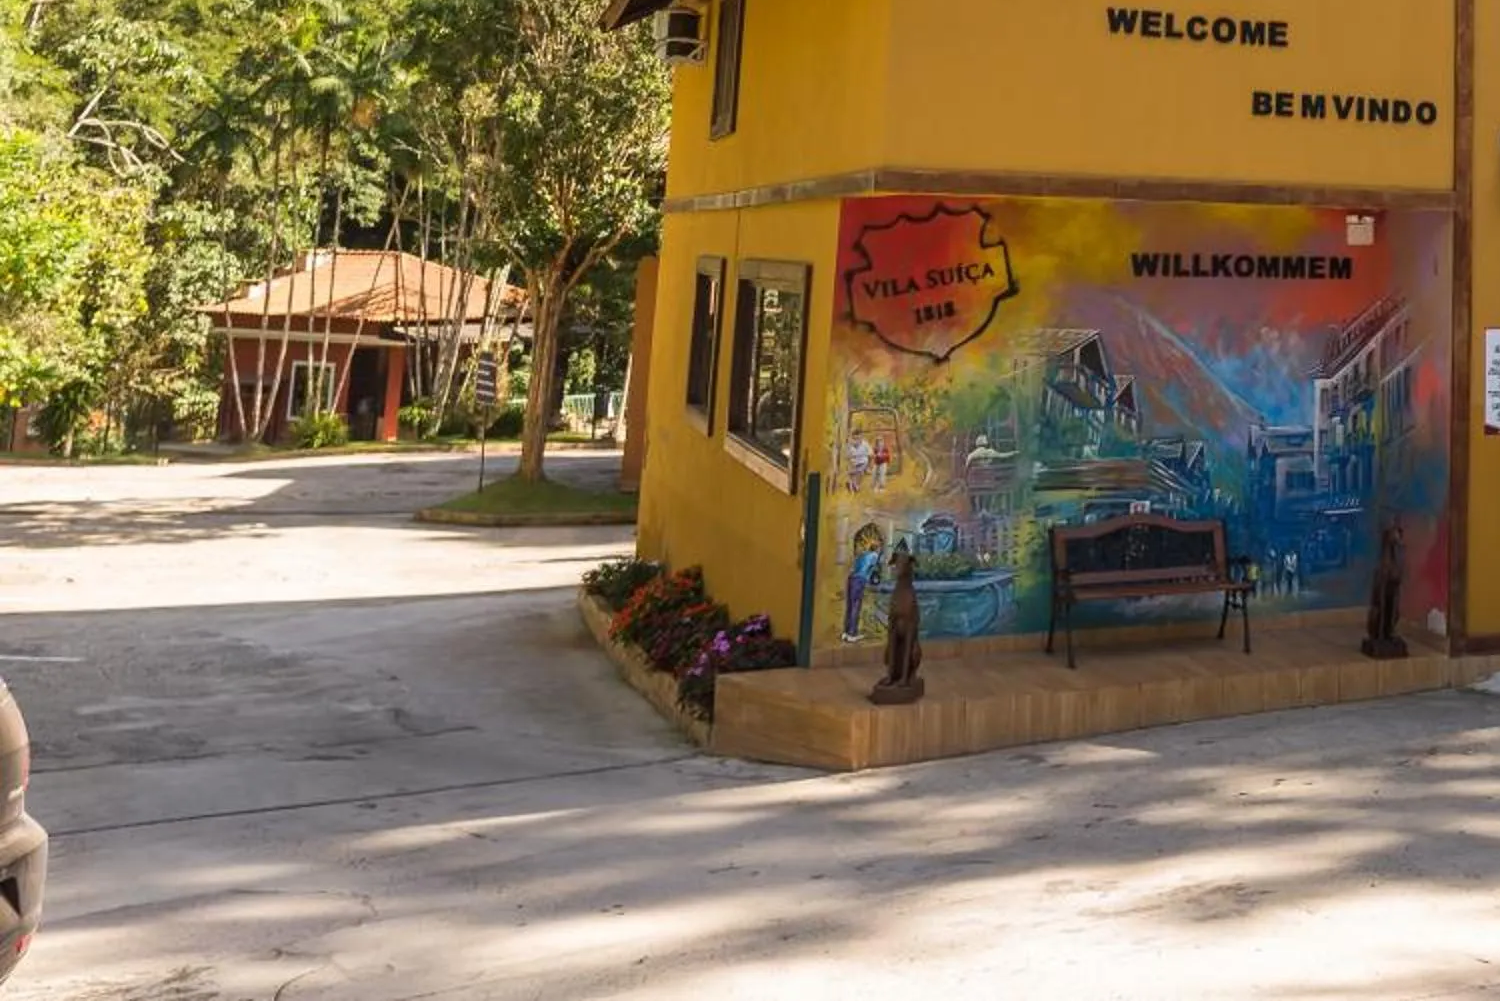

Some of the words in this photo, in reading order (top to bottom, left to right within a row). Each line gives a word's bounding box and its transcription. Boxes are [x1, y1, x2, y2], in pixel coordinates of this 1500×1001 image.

[1107, 7, 1289, 47] WELCOME
[863, 278, 921, 298] VILA
[926, 262, 995, 289] SUÍÇA
[1132, 253, 1353, 280] WILLKOMMEM
